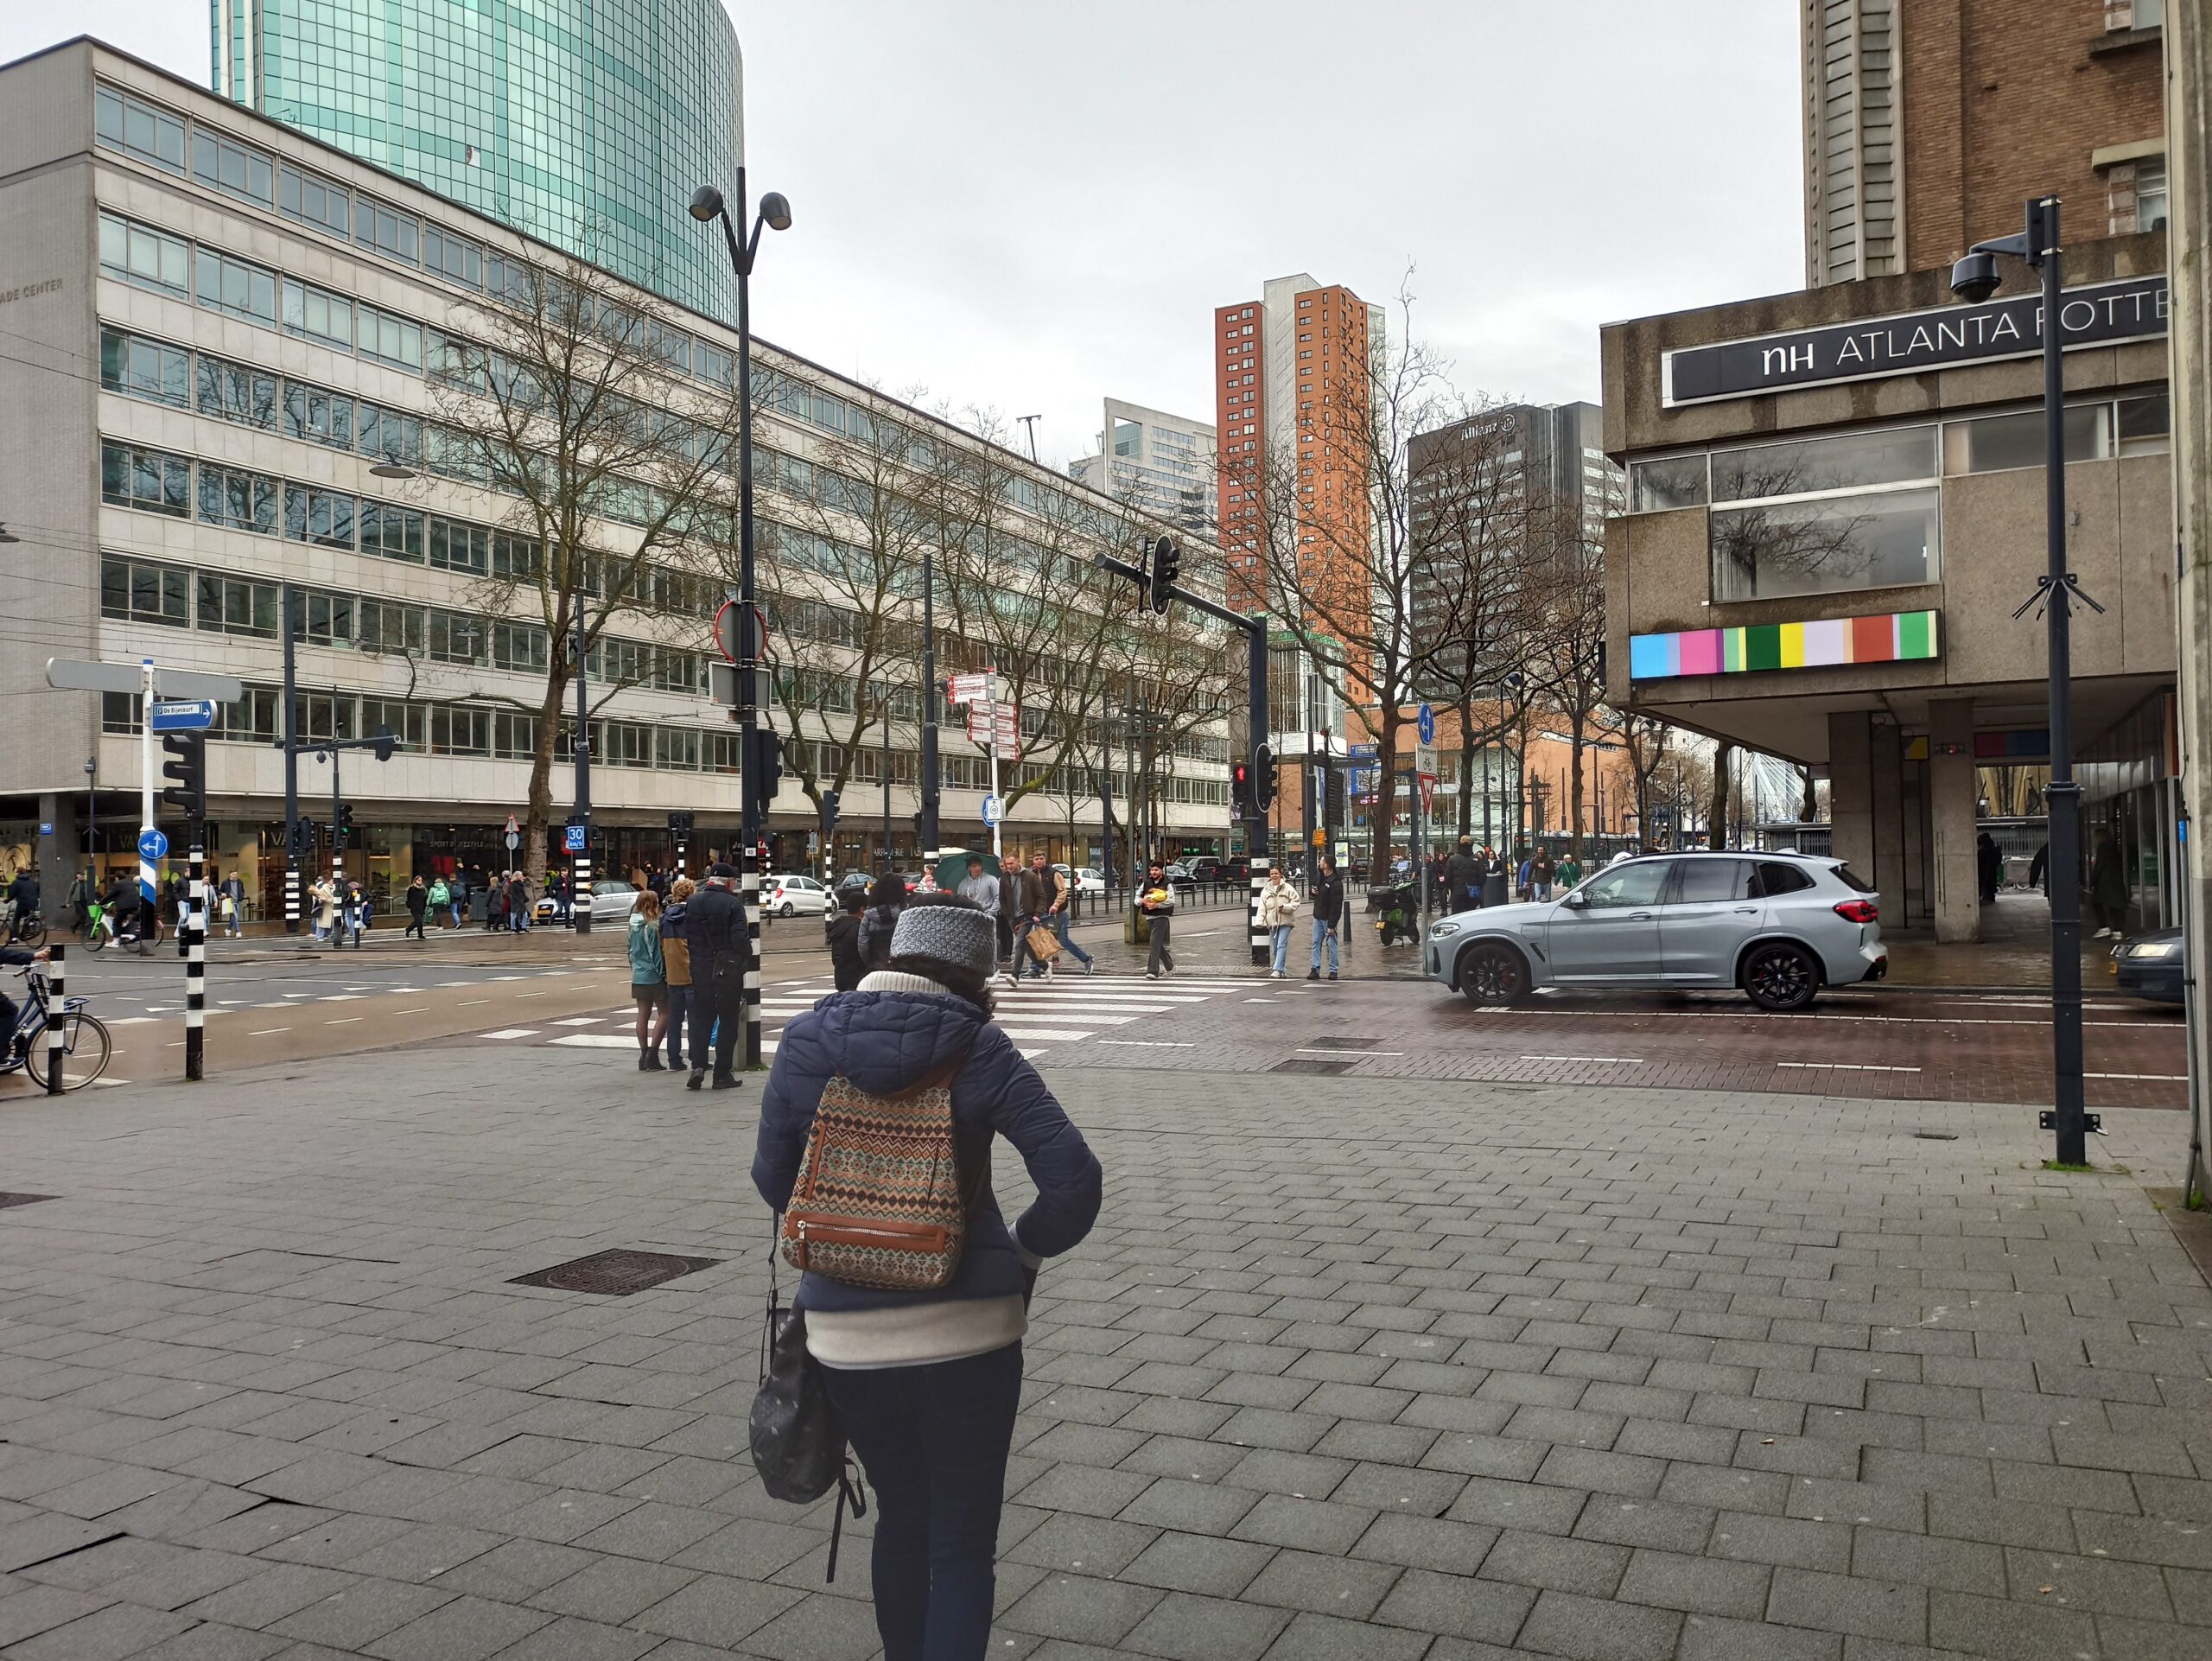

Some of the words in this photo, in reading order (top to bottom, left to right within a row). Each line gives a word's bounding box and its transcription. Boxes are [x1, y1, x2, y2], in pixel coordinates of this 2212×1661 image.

[23, 278, 63, 297] CENTER
[1836, 312, 2020, 366] ATLANTA
[569, 828, 582, 840] 30
